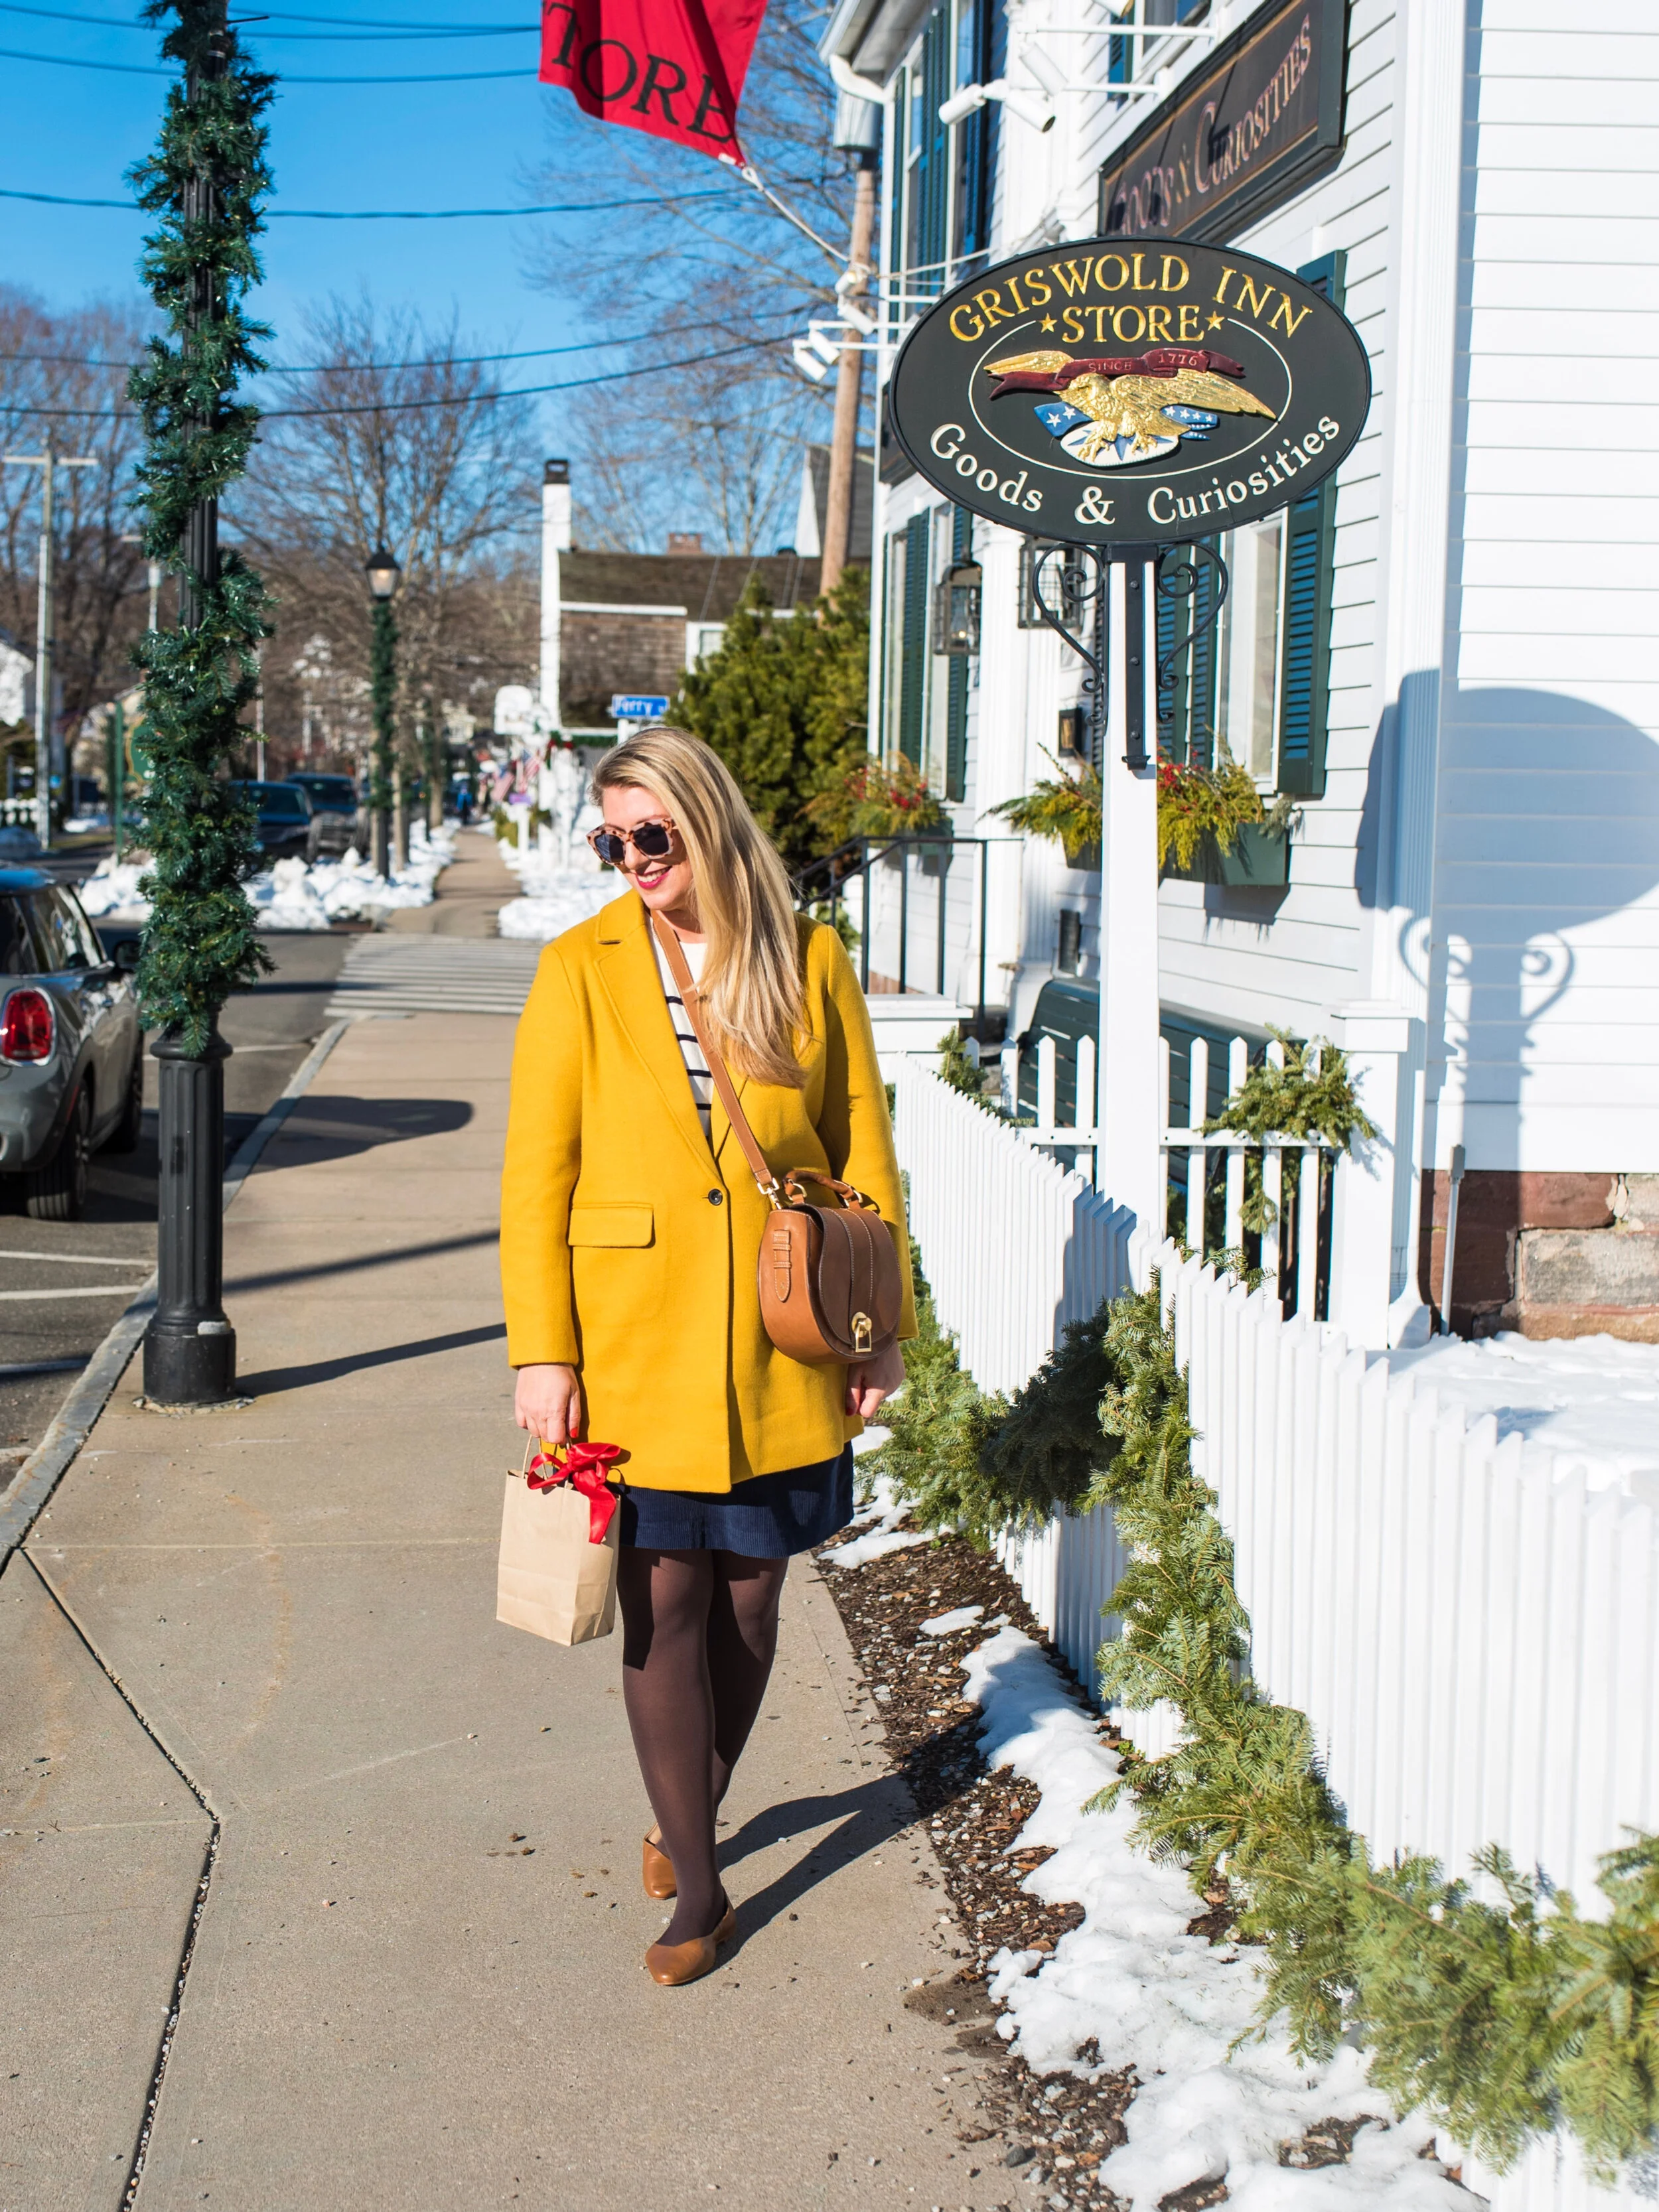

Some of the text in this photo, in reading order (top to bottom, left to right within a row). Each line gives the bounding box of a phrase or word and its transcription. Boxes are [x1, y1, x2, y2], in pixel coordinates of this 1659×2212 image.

[543, 1, 733, 144] TORE
[1194, 13, 1311, 194] CURIOSITIES
[949, 252, 1313, 342] GRISWOLD INN
[1062, 304, 1206, 343] STORE
[1088, 352, 1199, 373] SINCE 1776
[930, 414, 1340, 525] Goods & Curiosities
